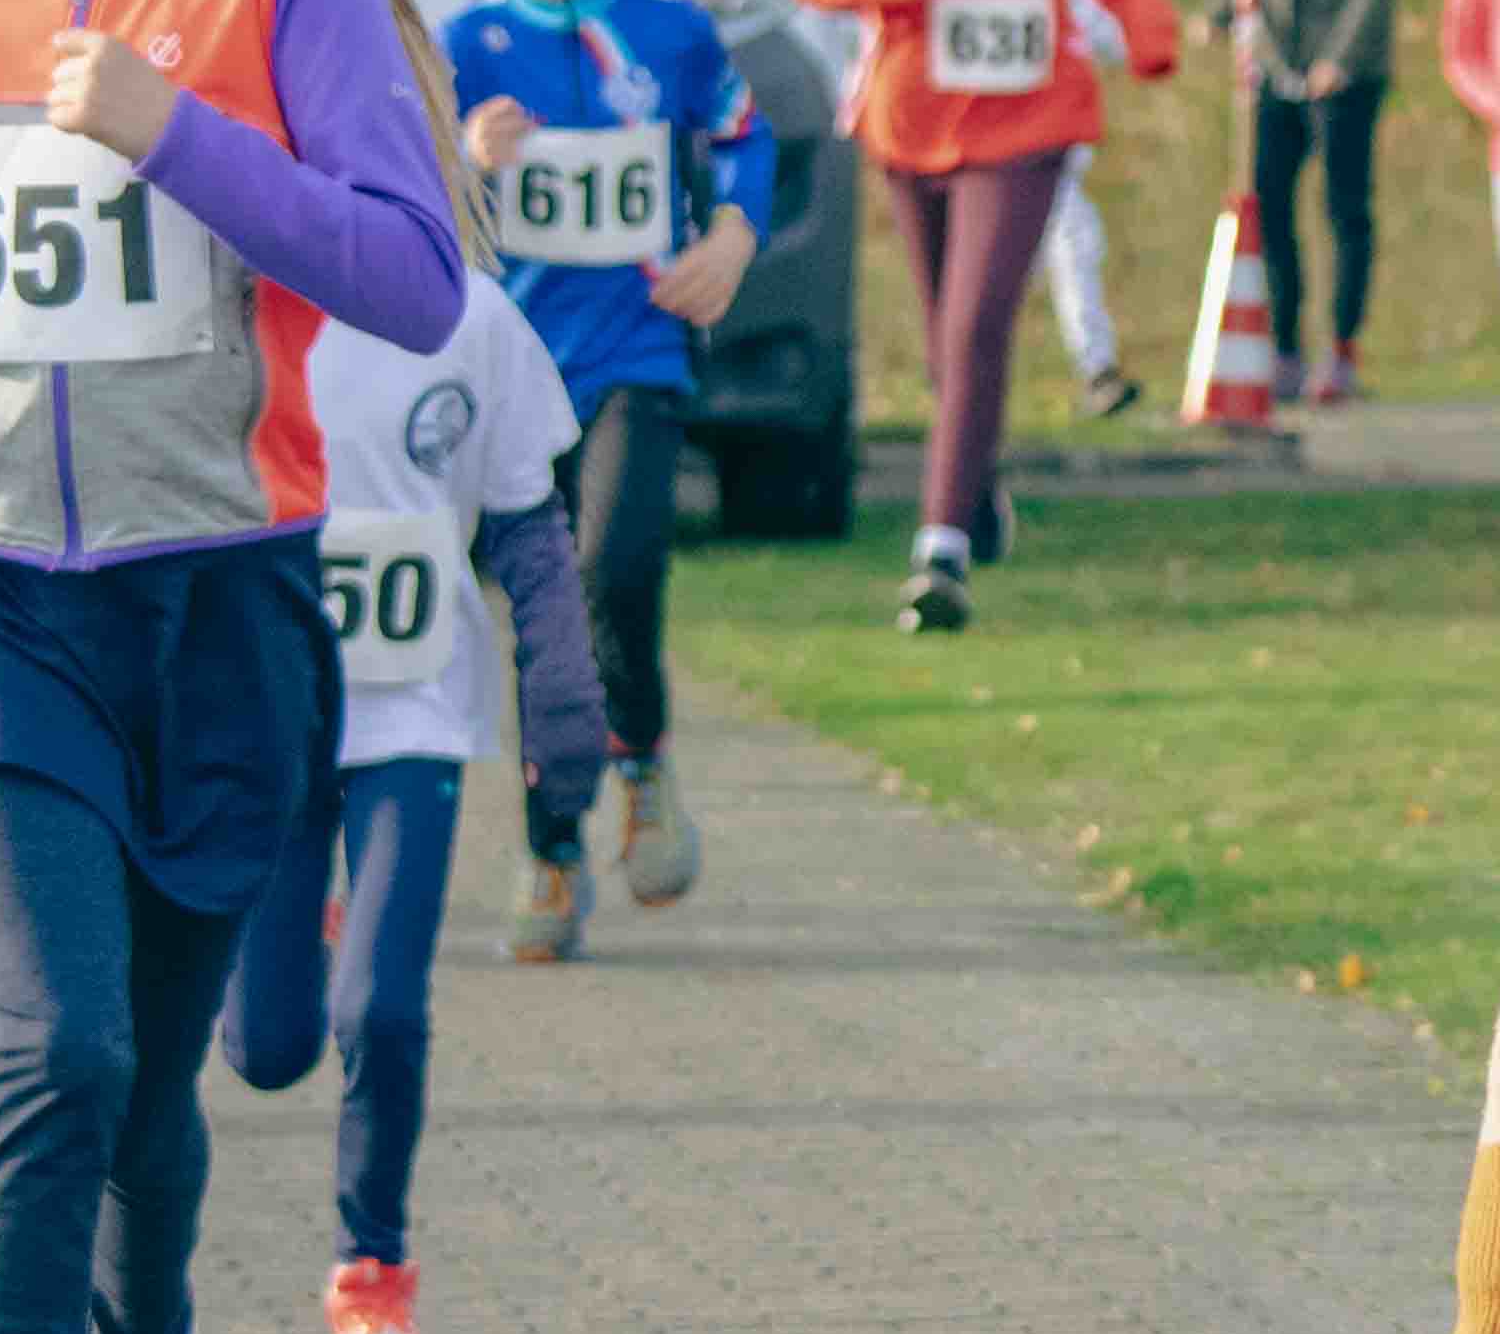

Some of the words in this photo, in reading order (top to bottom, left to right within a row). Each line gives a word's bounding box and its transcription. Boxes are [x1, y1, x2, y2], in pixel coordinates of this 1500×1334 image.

[947, 12, 1046, 64] 638
[520, 160, 657, 230] 616
[321, 553, 438, 642] 50
